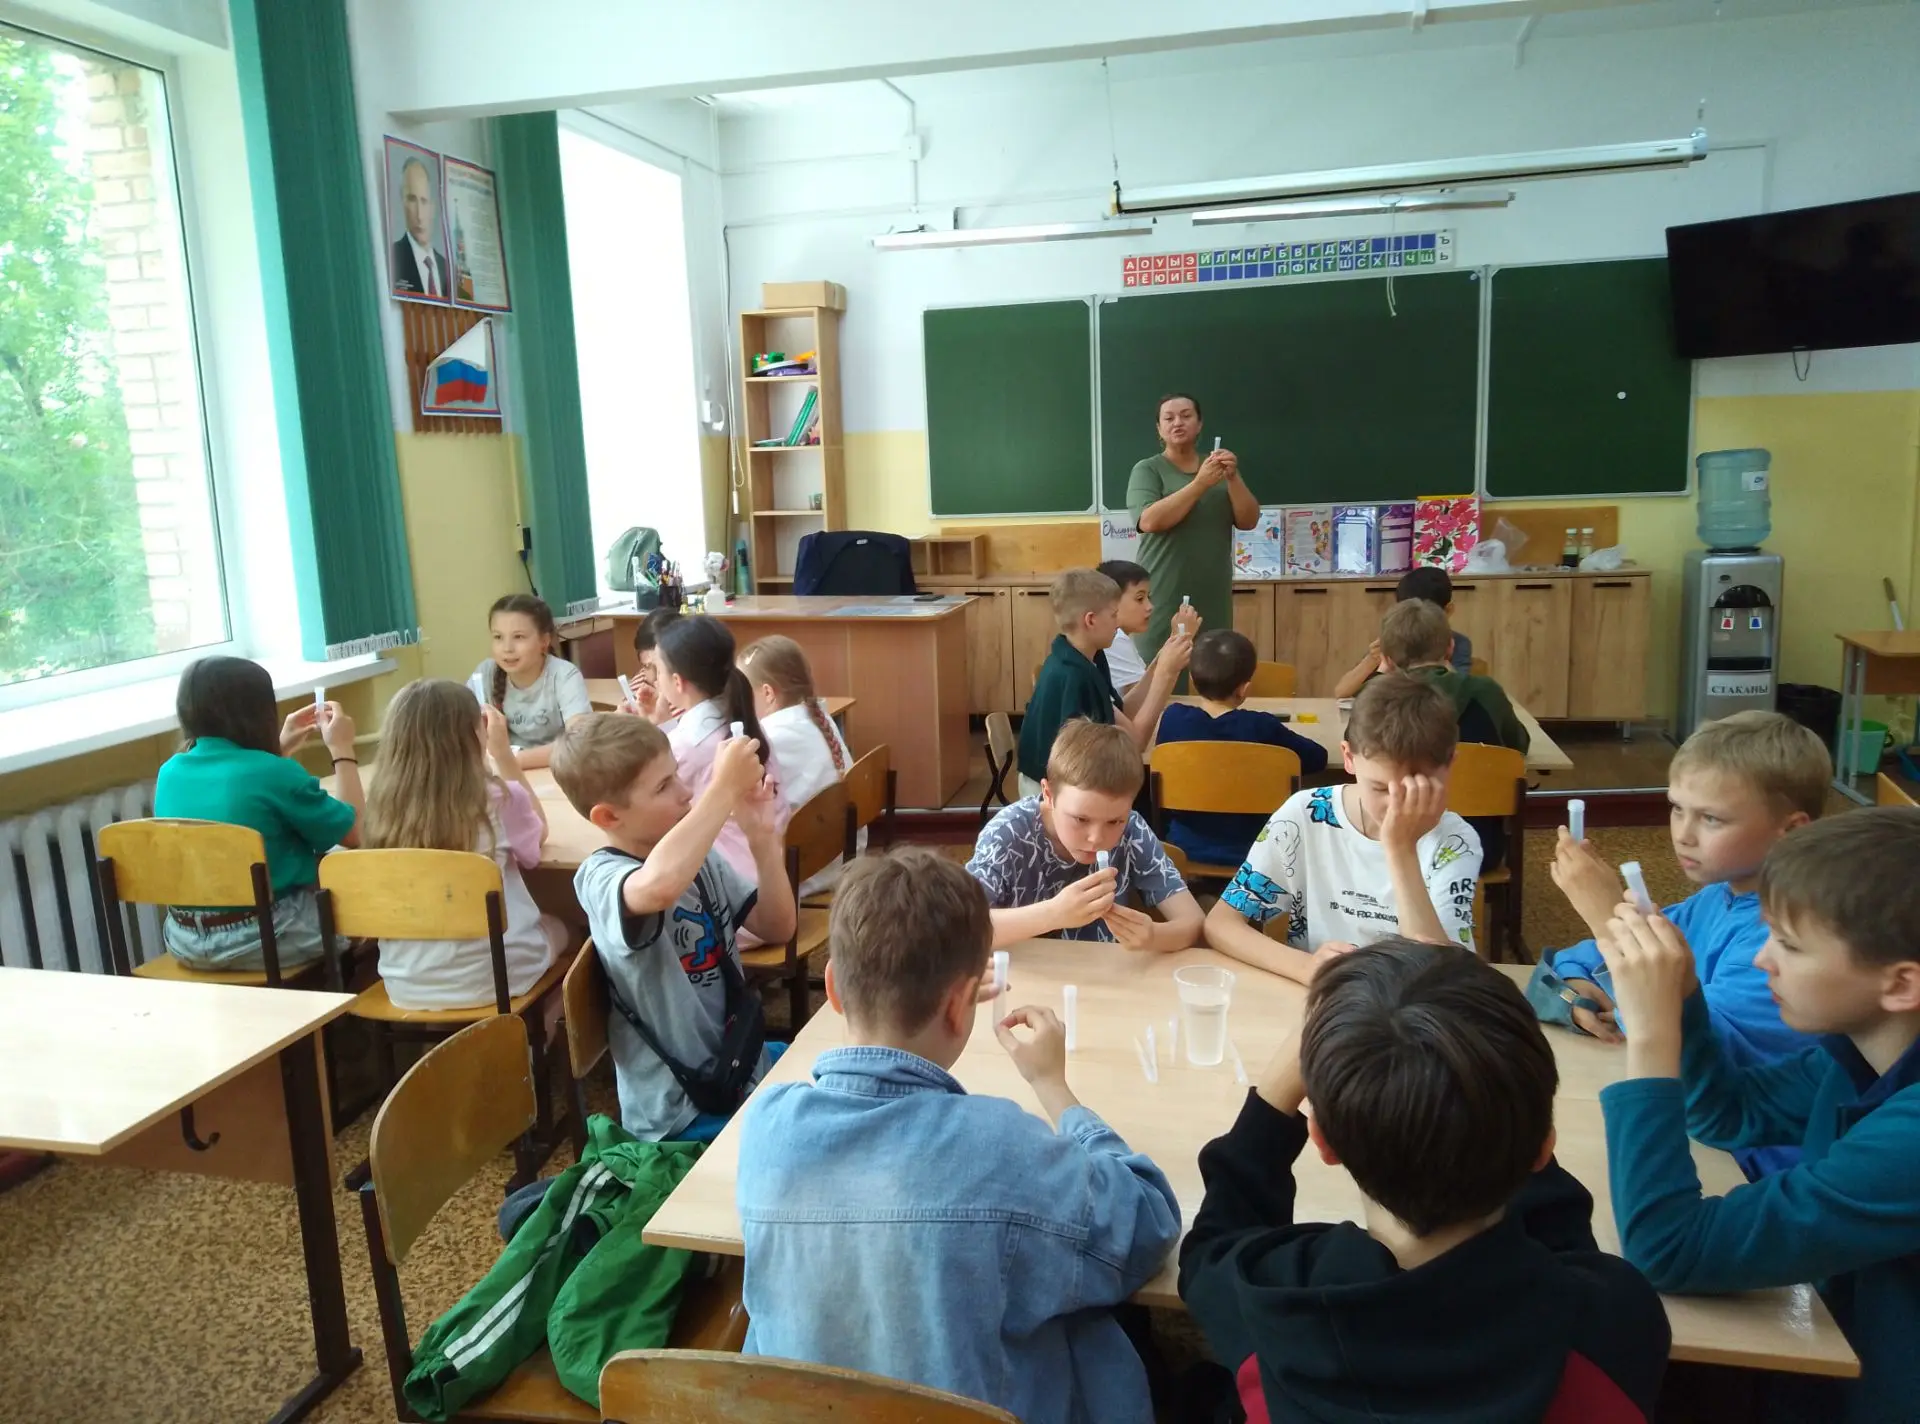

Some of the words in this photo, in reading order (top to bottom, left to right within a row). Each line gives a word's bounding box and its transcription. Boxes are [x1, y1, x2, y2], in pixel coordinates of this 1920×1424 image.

[1126, 261, 1134, 270] А
[1141, 260, 1149, 268] О
[1157, 259, 1164, 267] У
[1170, 258, 1180, 266] Ы
[1200, 254, 1210, 264] Й
[1231, 253, 1240, 261] М
[1247, 251, 1256, 260] Н
[1263, 251, 1270, 259] Р
[1279, 248, 1286, 258] Б
[1295, 248, 1302, 256] В
[1325, 245, 1335, 255] Д
[1359, 242, 1367, 251] З
[1141, 275, 1148, 283] Ё
[1155, 274, 1164, 282] Ю
[1171, 273, 1179, 281] И
[1186, 272, 1194, 280] Е
[1278, 263, 1286, 273] П
[1310, 262, 1318, 271] К
[1326, 261, 1334, 270] Т
[1357, 259, 1366, 267] С
[1711, 685, 1768, 694] СТАКАНЫ
